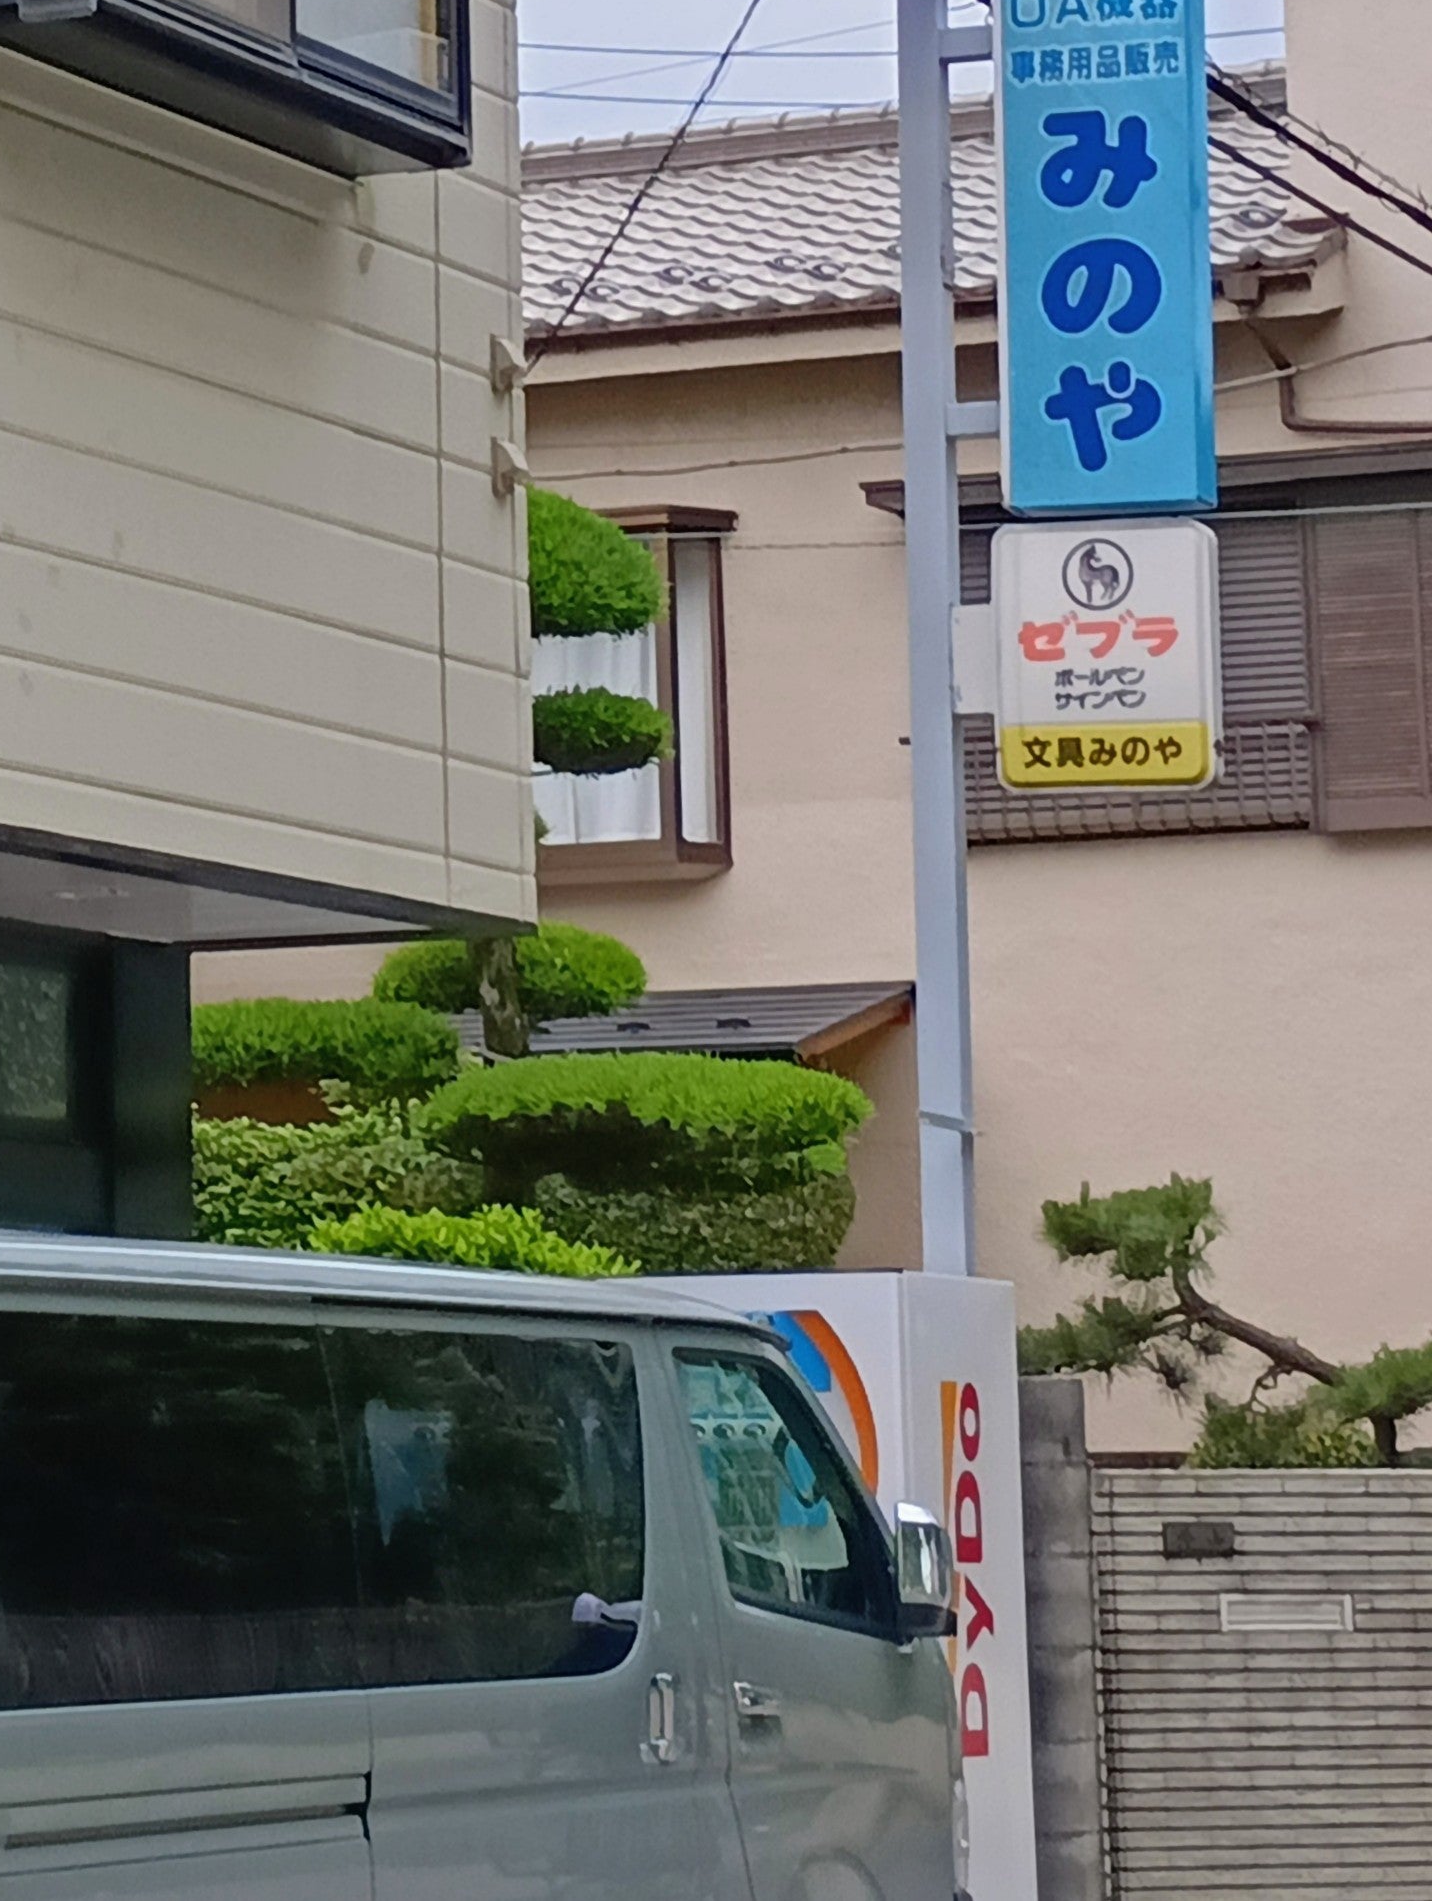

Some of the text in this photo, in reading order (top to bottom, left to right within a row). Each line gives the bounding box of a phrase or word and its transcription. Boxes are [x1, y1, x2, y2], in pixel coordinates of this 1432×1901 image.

[1011, 41, 1179, 83] 事務用品販売
[1040, 110, 1162, 472] みのや
[1019, 610, 1178, 662] ゼブラ
[1054, 666, 1145, 687] ボールペン
[1054, 689, 1147, 710] サインペン
[1022, 736, 1183, 769] 文具みのや
